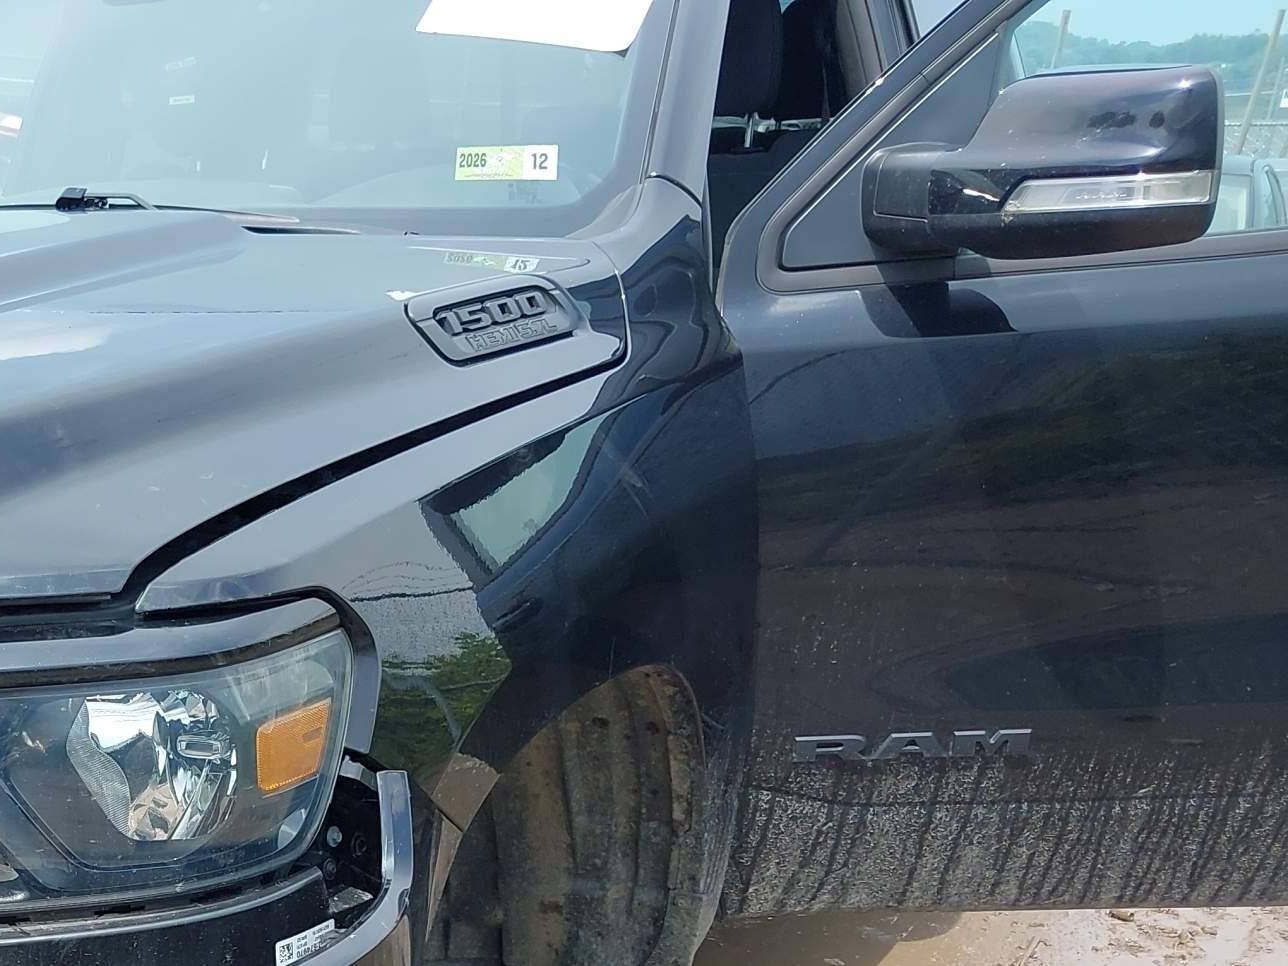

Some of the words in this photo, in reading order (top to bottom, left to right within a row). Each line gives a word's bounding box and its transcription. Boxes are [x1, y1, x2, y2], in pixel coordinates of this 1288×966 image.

[459, 152, 487, 168] 2026
[531, 152, 549, 170] 12
[435, 290, 547, 336] 1500
[466, 324, 517, 352] HEMI
[793, 728, 1033, 763] RAM
